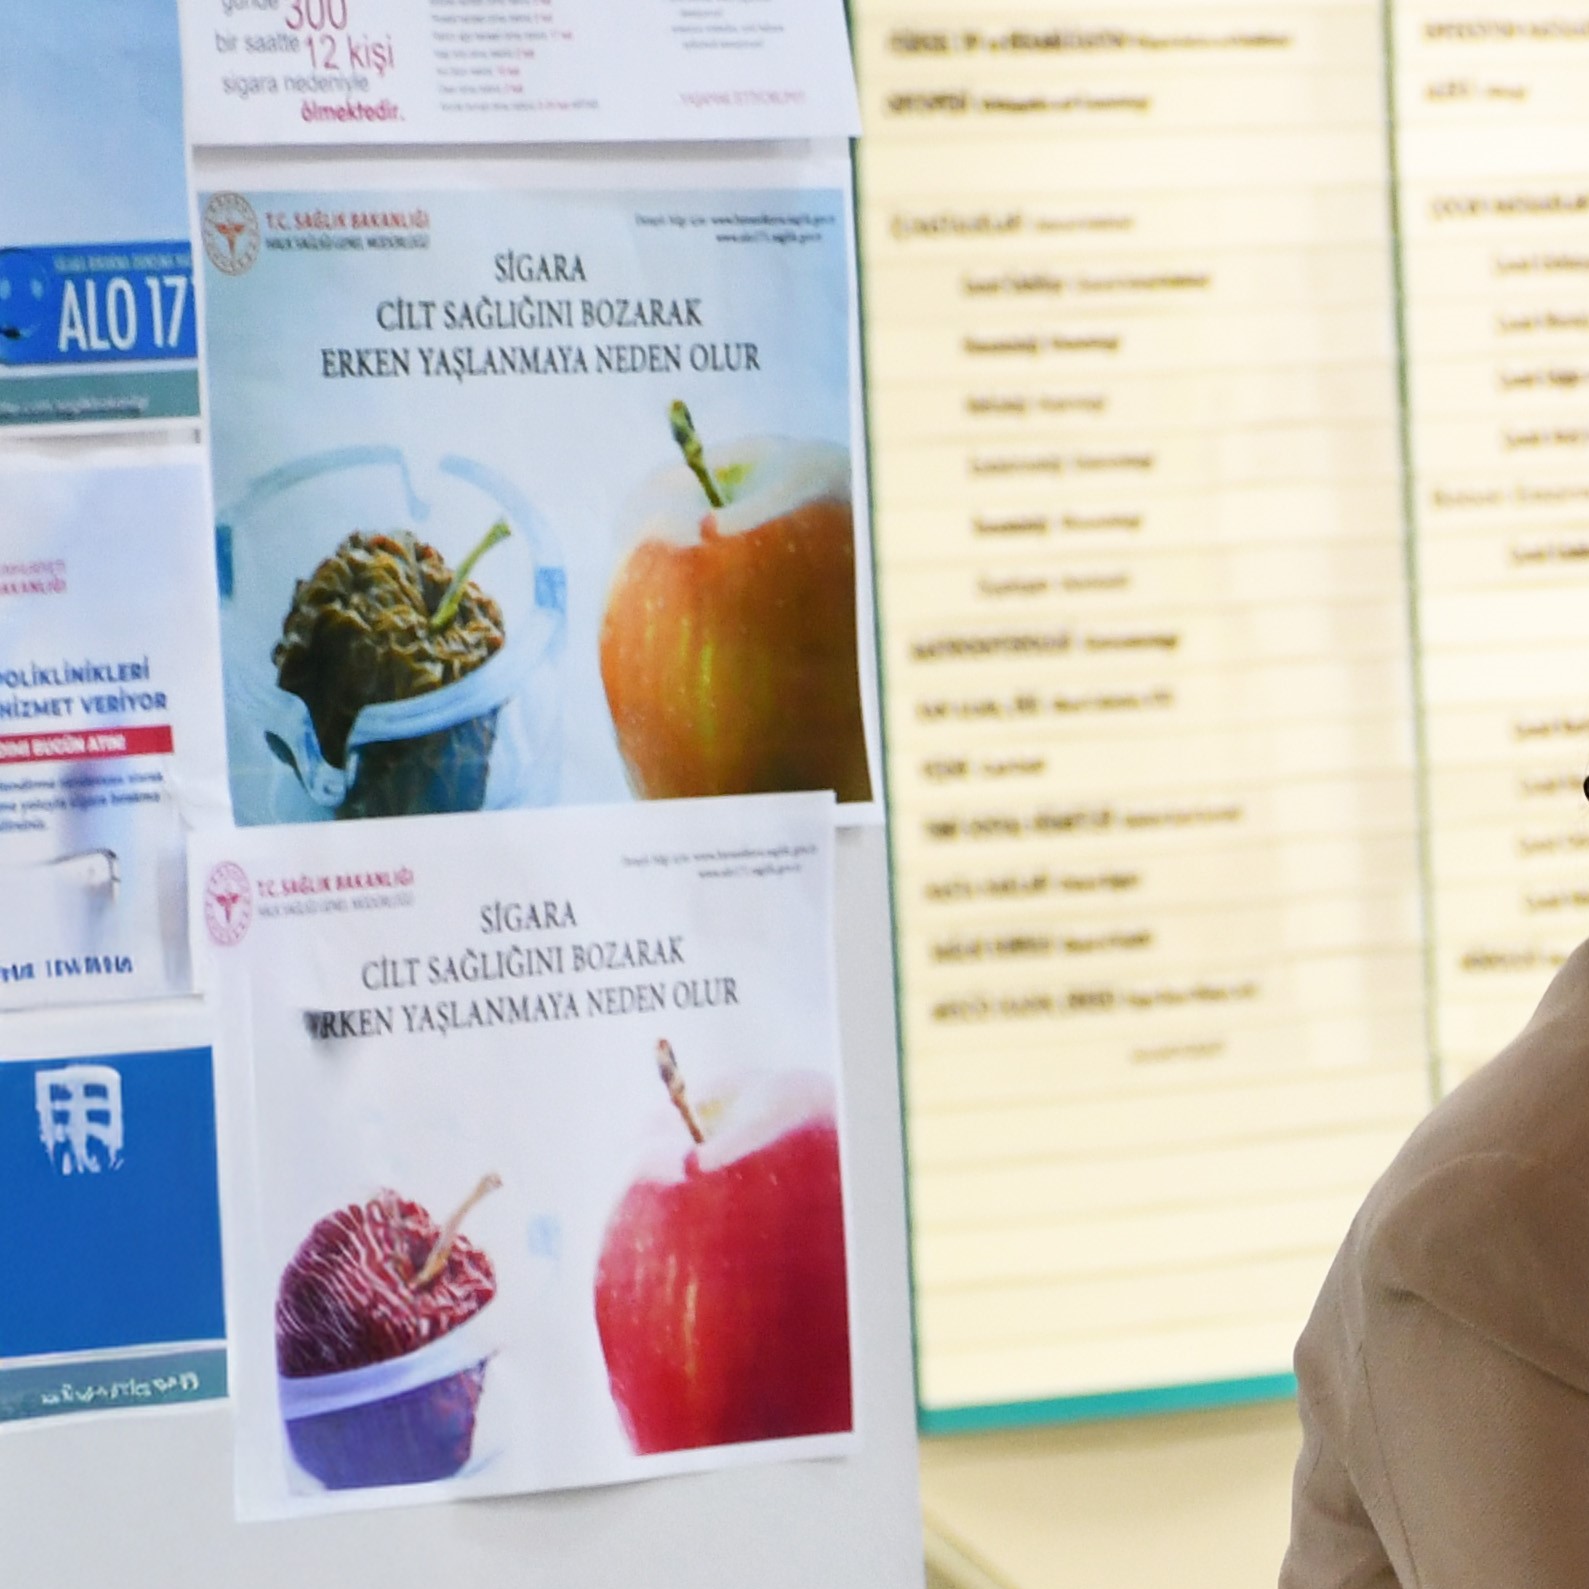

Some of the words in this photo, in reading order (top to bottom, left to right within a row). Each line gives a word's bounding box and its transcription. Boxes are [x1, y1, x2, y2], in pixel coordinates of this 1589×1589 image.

[285, 0, 348, 31] 300
[305, 34, 339, 70] 12
[347, 34, 395, 77] kişi
[222, 72, 278, 98] sigara
[284, 72, 369, 101] nedeniyle
[301, 100, 405, 123] ölmektedir.
[294, 208, 348, 231] SAĞLIK
[351, 206, 431, 230] BAKANLIĞI
[495, 248, 588, 283] SİGARA
[58, 276, 138, 352] ALO
[145, 273, 195, 349] 17
[376, 293, 437, 331] CİLT
[444, 293, 574, 331] SAĞLIĞINI
[581, 296, 703, 329] BOZARAK
[321, 346, 410, 379] ERKEN
[418, 345, 589, 383] YAŞLANMAYA
[596, 343, 682, 374] NEDEN
[690, 342, 762, 372] OLUR
[80, 686, 167, 715] VERİYOR
[281, 874, 332, 896] SAĞLIK
[335, 866, 415, 892] BAKANLIĞI
[480, 900, 579, 935] SİGARA
[361, 953, 421, 991] CİLT
[428, 946, 565, 986] SAĞLIĞINI
[572, 936, 685, 972] BOZARAK
[400, 992, 581, 1039] YAŞLANMAYA
[587, 982, 667, 1015] NEDEN
[672, 976, 740, 1009] OLUR
